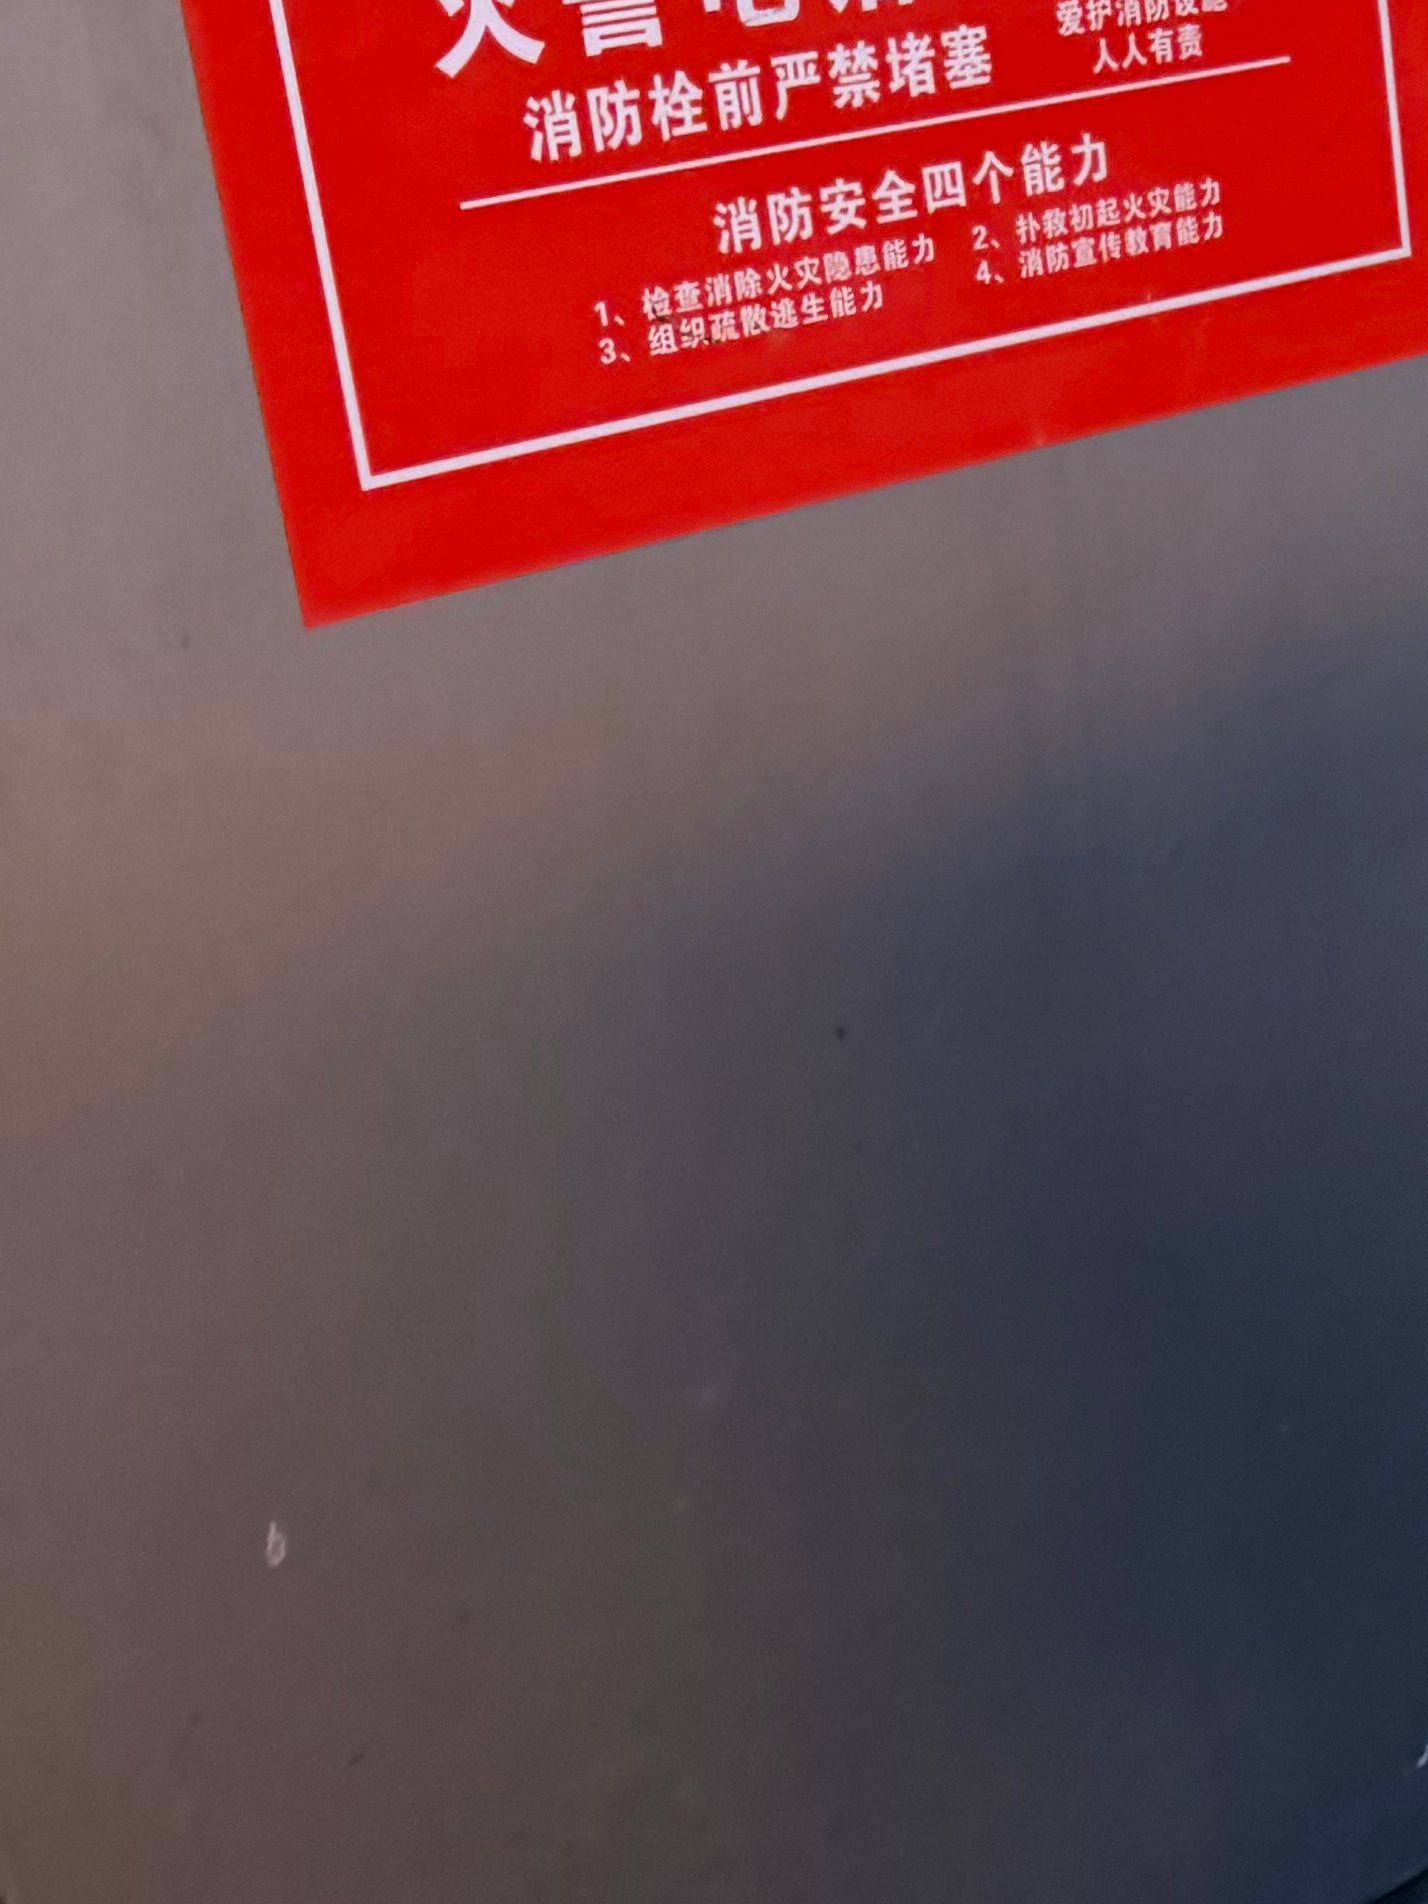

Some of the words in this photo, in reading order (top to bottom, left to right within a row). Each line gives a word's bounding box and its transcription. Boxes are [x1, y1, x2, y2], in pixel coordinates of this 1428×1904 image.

[523, 25, 993, 162] 消防栓前严禁堵塞
[1093, 24, 1202, 74] 人人有责
[713, 133, 1107, 254] 消防安全四个能力
